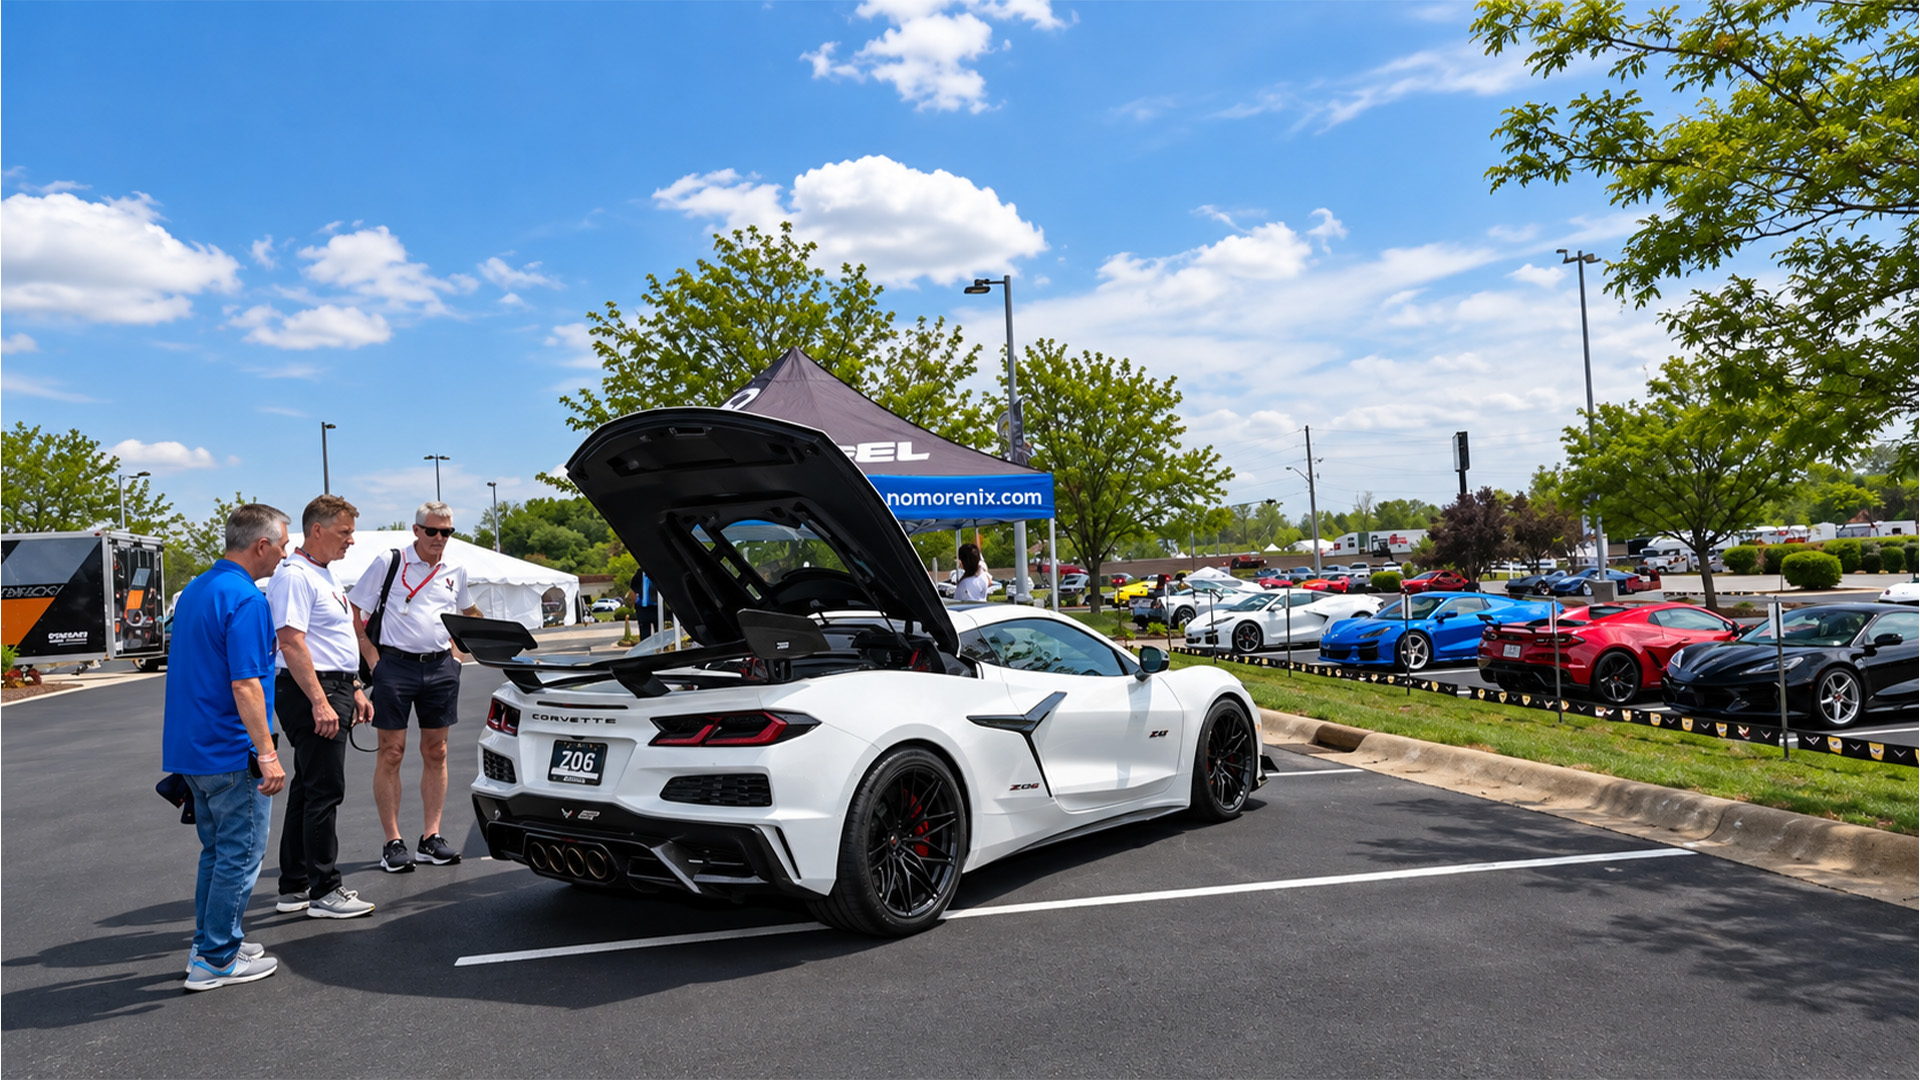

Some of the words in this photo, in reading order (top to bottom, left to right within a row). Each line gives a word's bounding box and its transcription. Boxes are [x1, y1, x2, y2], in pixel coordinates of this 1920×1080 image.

[887, 488, 1042, 506] nomorenix.com
[532, 714, 616, 724] CORVETTE
[559, 750, 596, 772] Z06
